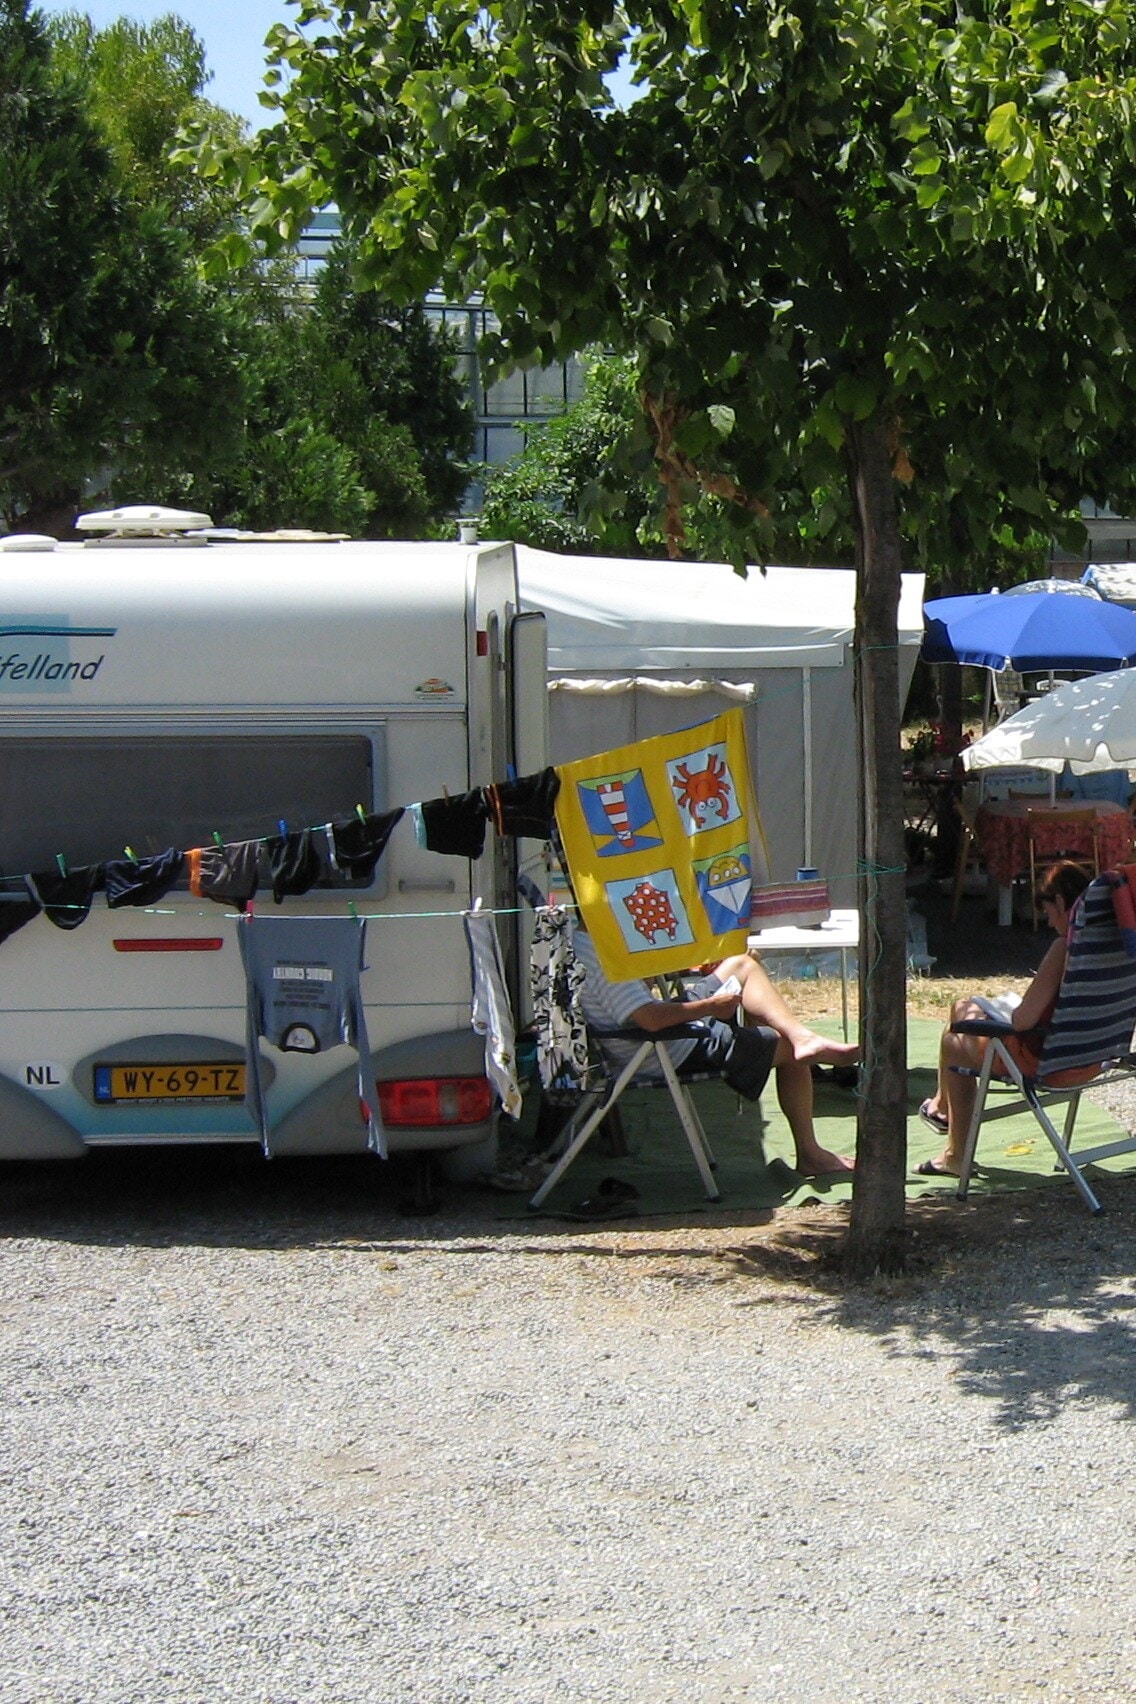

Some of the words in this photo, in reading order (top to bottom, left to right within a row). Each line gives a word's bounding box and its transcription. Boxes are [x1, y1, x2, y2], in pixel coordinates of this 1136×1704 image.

[0, 653, 105, 680] felland
[26, 1066, 60, 1085] NL
[123, 1069, 240, 1094] WY-69-TZ
